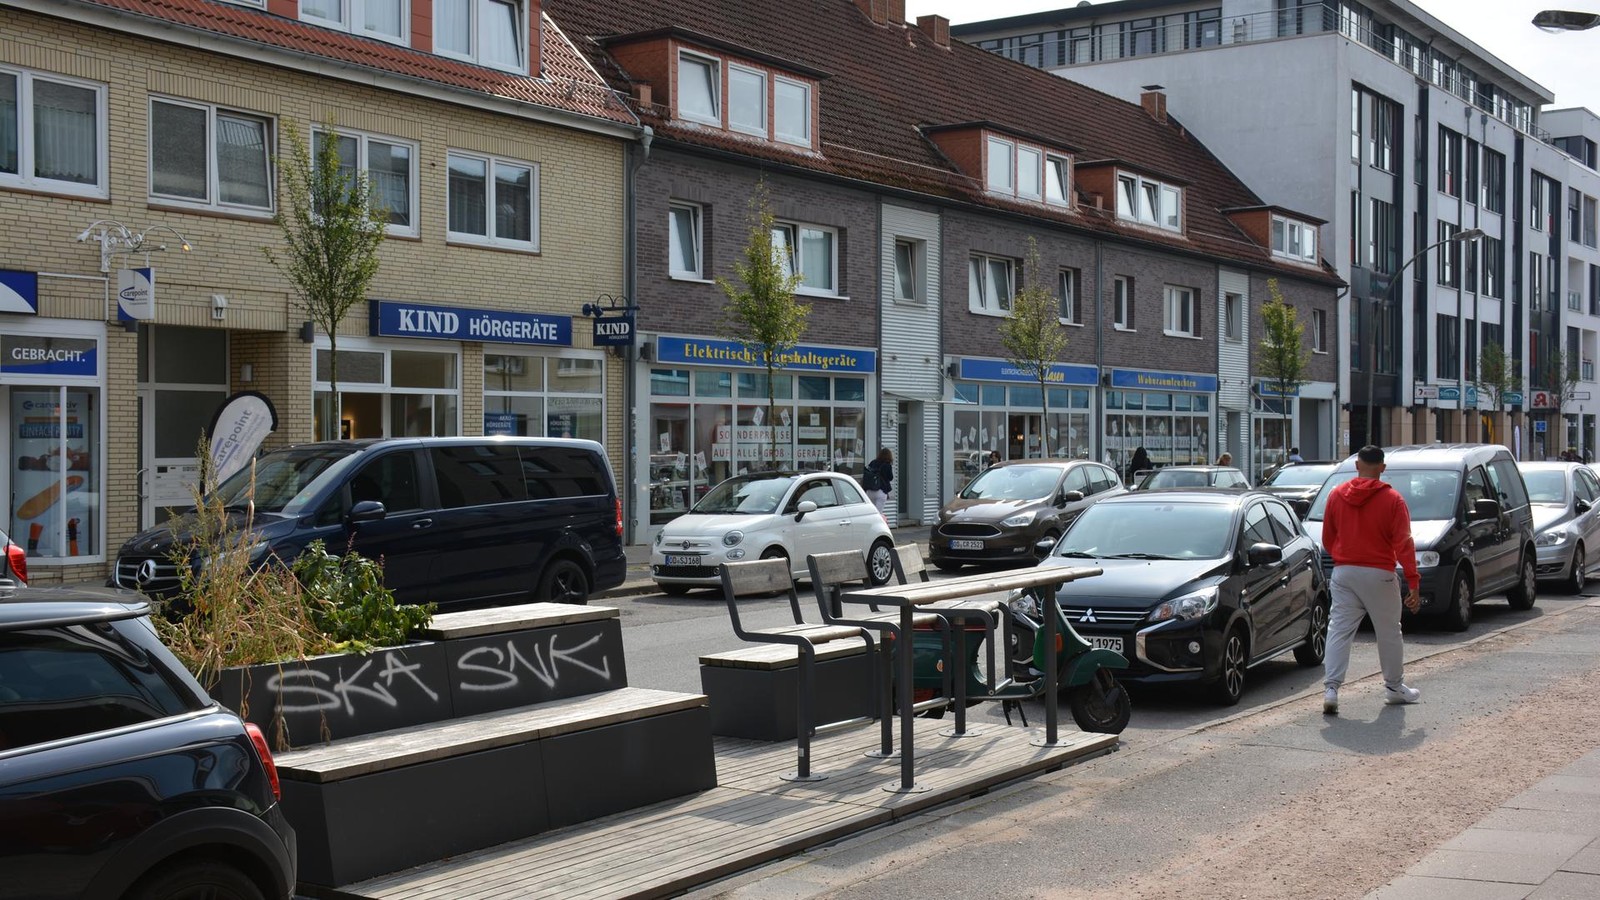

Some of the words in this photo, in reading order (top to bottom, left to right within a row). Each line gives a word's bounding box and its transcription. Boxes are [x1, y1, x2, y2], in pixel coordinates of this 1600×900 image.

[123, 288, 148, 298] carepoint
[215, 307, 223, 317] 17
[398, 308, 460, 334] KIND
[469, 314, 558, 341] HÖRGERÄTE
[596, 322, 630, 335] KIND
[12, 347, 85, 362] GEBRACHT.
[684, 343, 757, 361] Elektrische
[214, 410, 252, 468] carepoint
[714, 448, 730, 457] AUF
[737, 448, 757, 457] ALLE
[797, 447, 826, 458] GERÄTE
[1096, 638, 1122, 651] 1975
[266, 652, 438, 716] SKA
[457, 633, 611, 691] SNK
